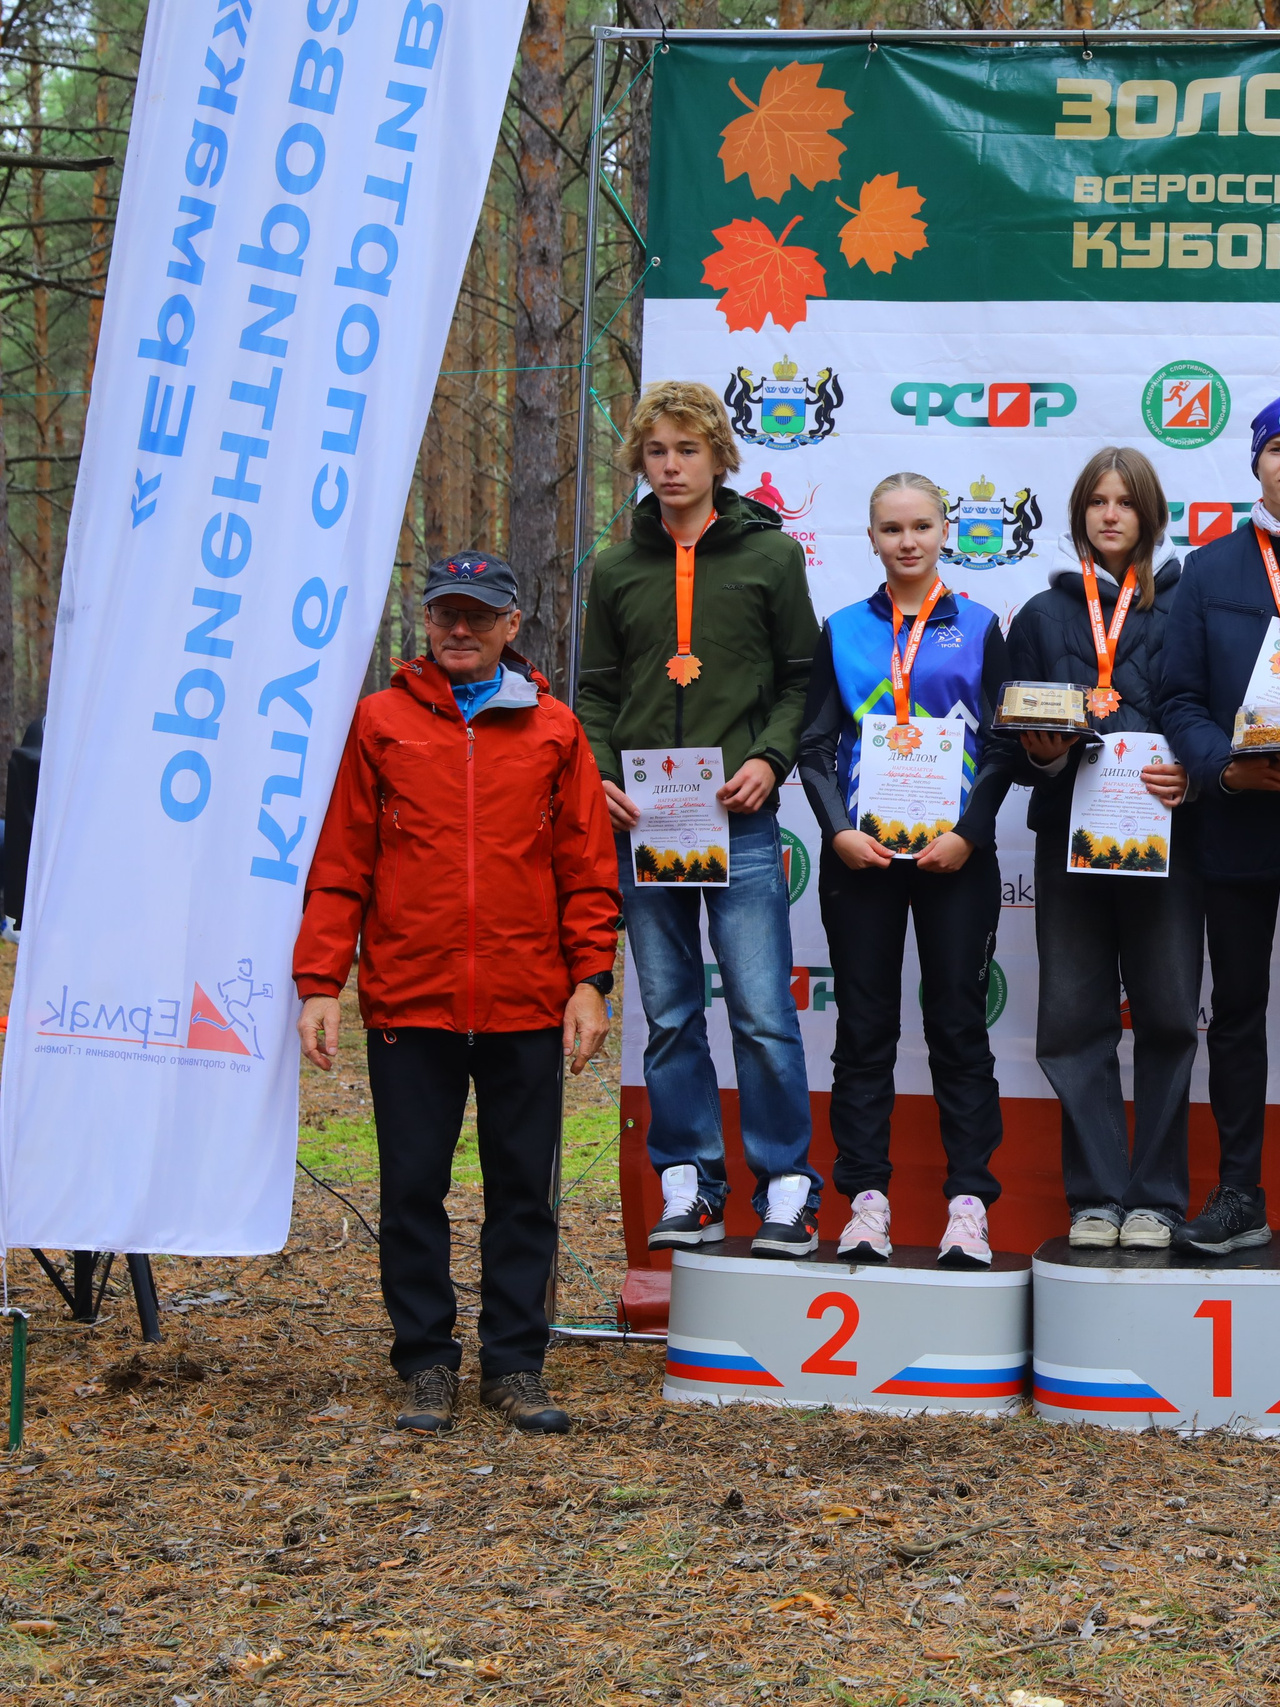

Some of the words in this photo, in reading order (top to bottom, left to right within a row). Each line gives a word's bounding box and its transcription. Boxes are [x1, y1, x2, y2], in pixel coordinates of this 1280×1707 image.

[652, 783, 701, 795] ДИПЛОМ
[1100, 767, 1144, 779] ДИПЛО
[801, 1291, 860, 1377] 2
[1193, 1300, 1232, 1398] 1
